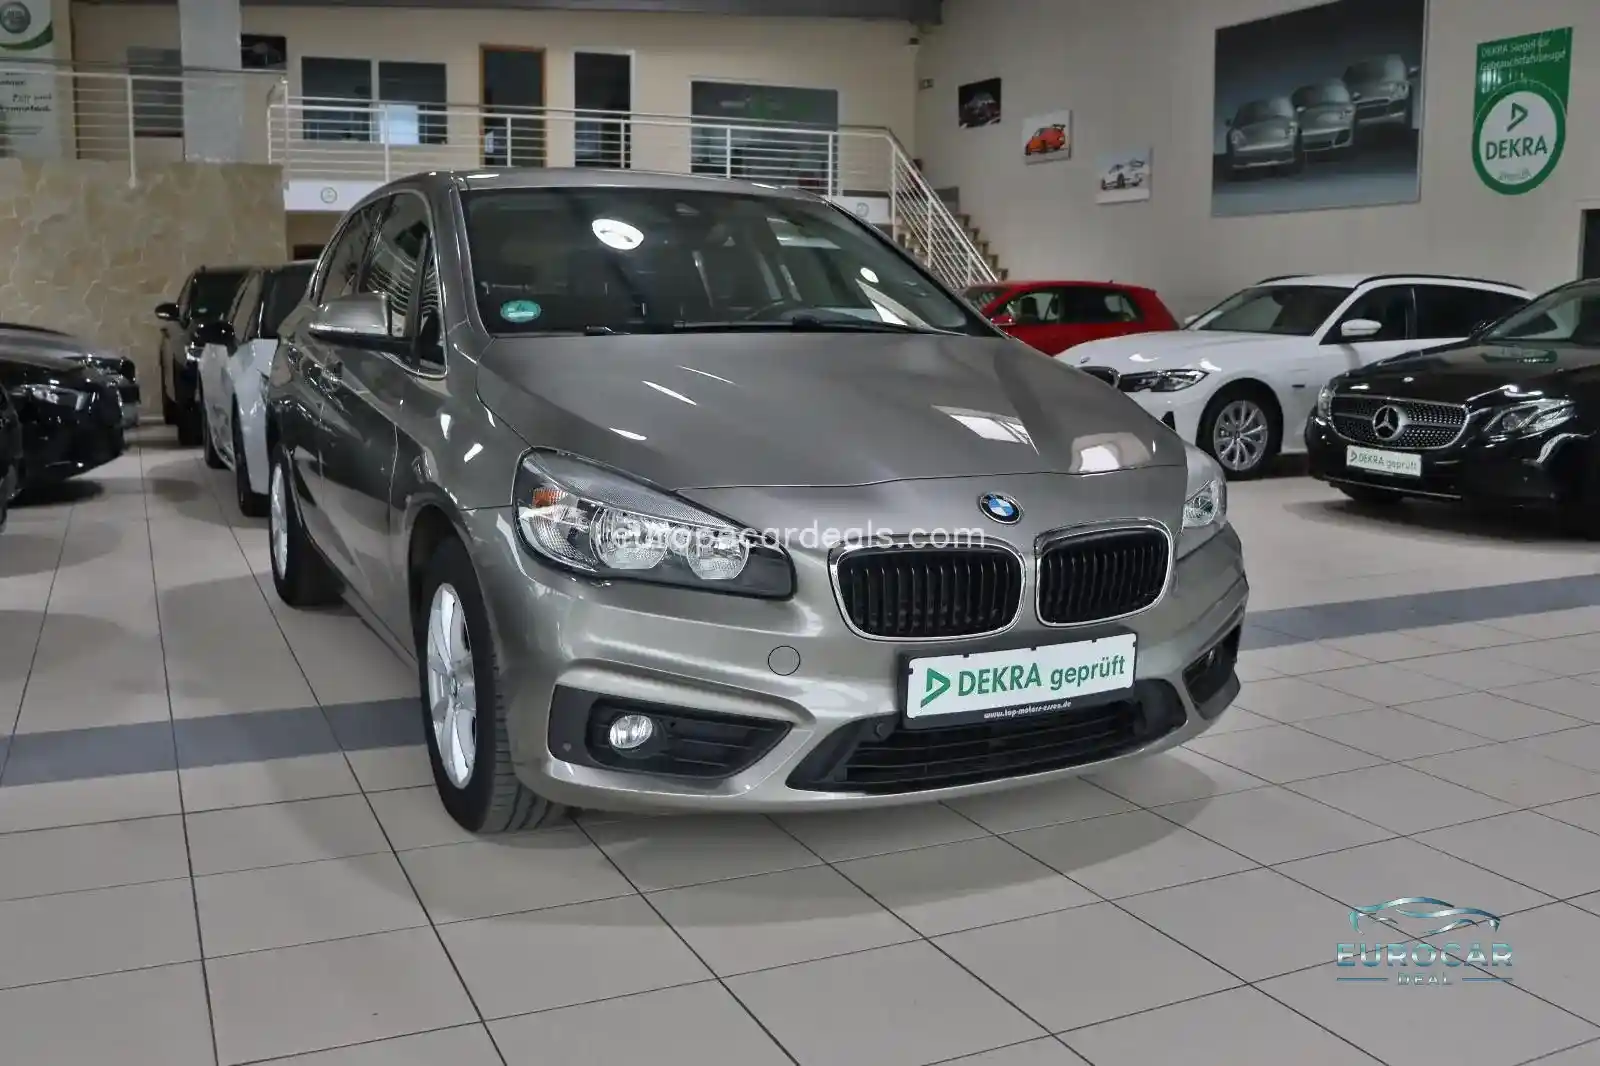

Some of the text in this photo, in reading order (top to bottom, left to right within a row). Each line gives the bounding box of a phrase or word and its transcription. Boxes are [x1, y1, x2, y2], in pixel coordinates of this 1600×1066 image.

[1485, 135, 1548, 160] DEKRA
[1358, 452, 1385, 465] DEKRA
[958, 654, 1126, 697] DEKRA geprüft
